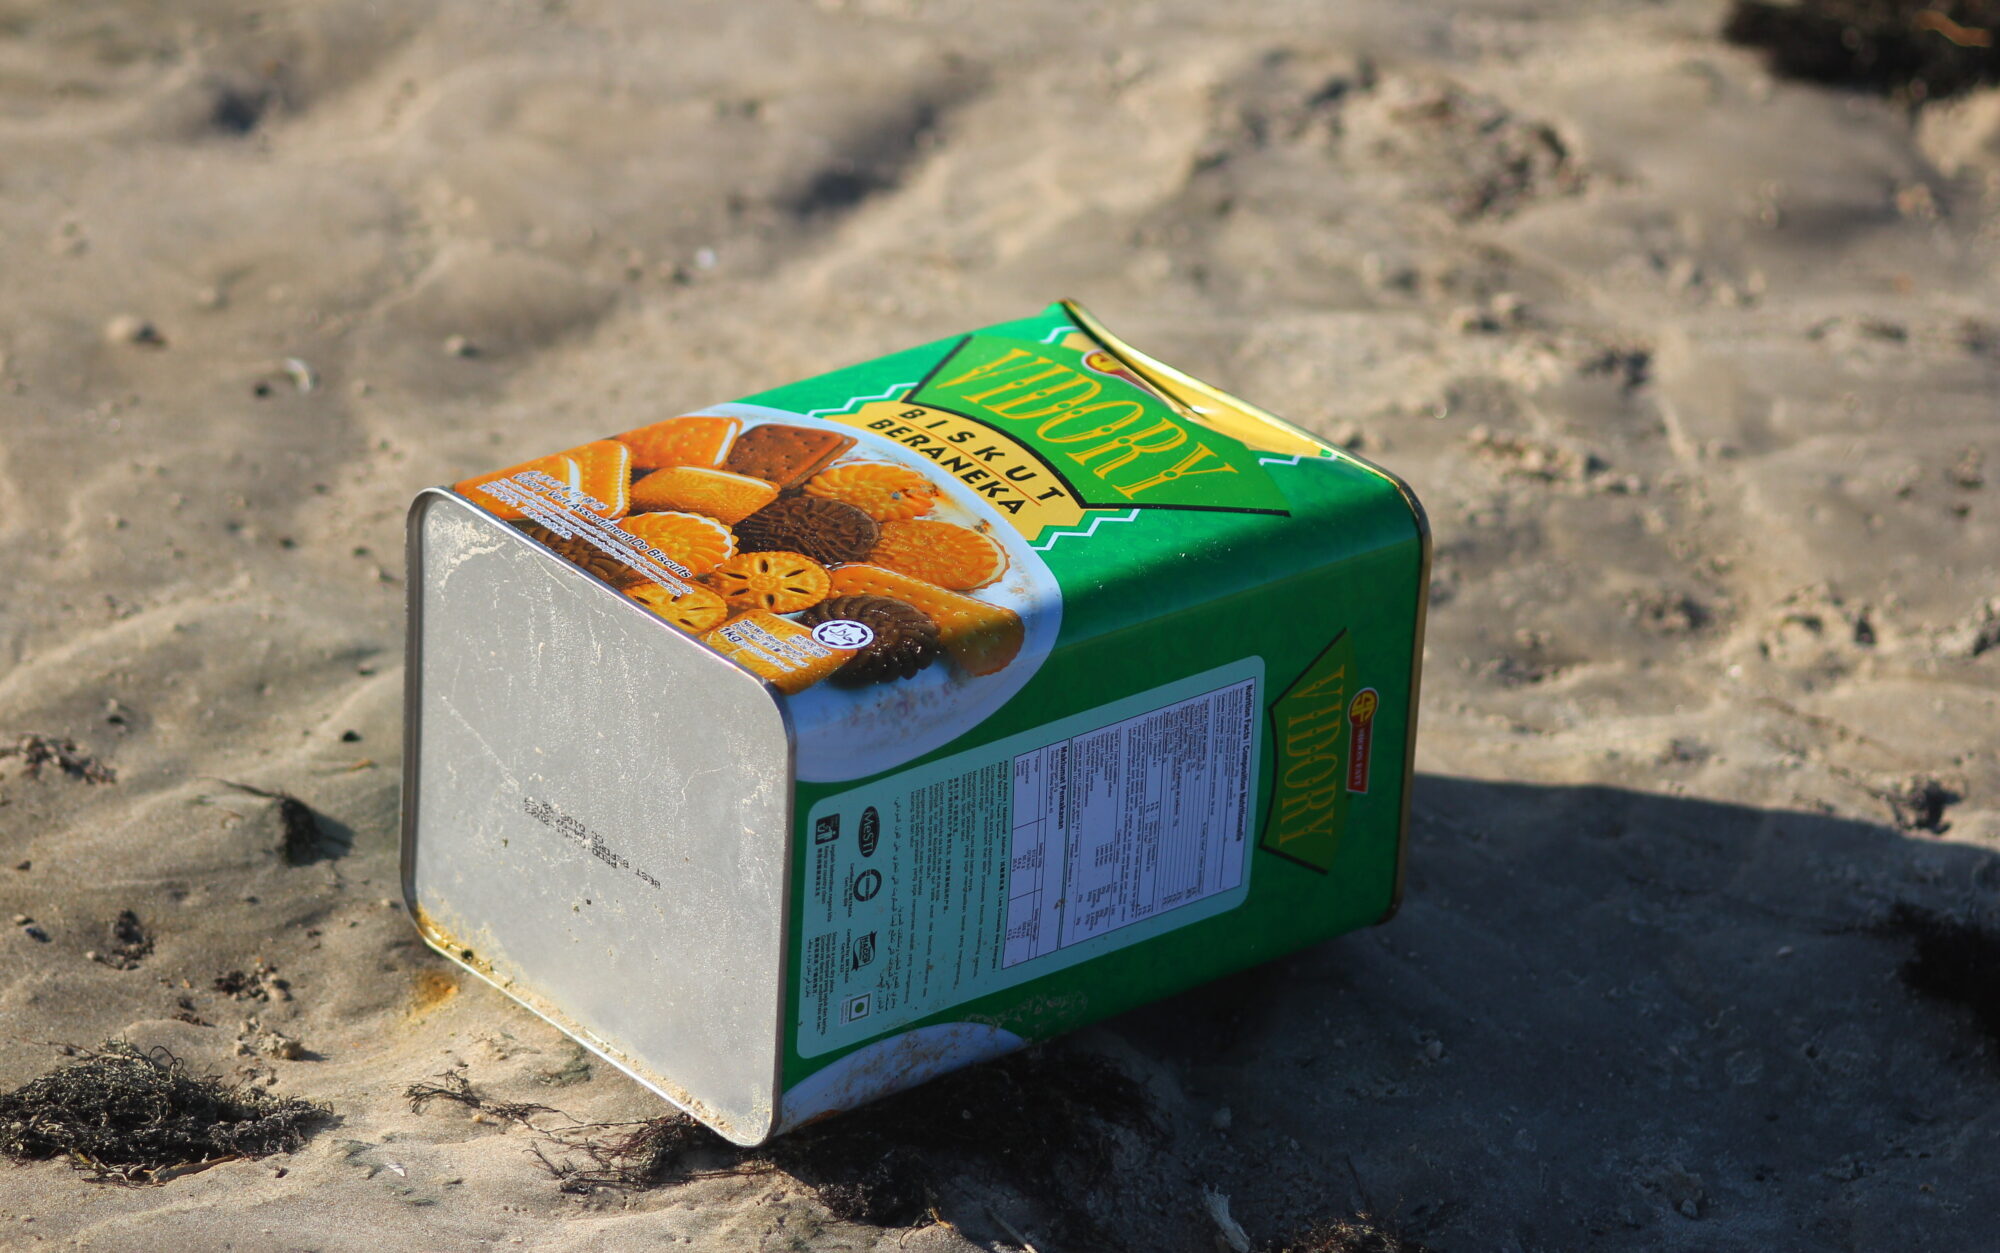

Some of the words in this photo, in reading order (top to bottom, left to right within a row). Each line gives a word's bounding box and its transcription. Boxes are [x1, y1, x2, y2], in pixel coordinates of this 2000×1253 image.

[936, 348, 1238, 500] VIDORY
[866, 418, 1029, 515] BERANEKA
[899, 407, 1068, 502] BISKUT
[547, 489, 573, 505] Vert
[568, 502, 636, 541] Assortiment
[630, 538, 649, 551] De
[646, 547, 693, 579] Biscuits
[719, 627, 742, 643] 1kg
[1243, 683, 1253, 719] Nutrition
[1241, 718, 1250, 741] Facts
[1058, 745, 1068, 785] Maklumat
[1238, 744, 1249, 792] Composition
[1278, 663, 1346, 845] VIDORY
[1057, 784, 1066, 830] Pemakanan
[861, 809, 875, 855] MeSTI
